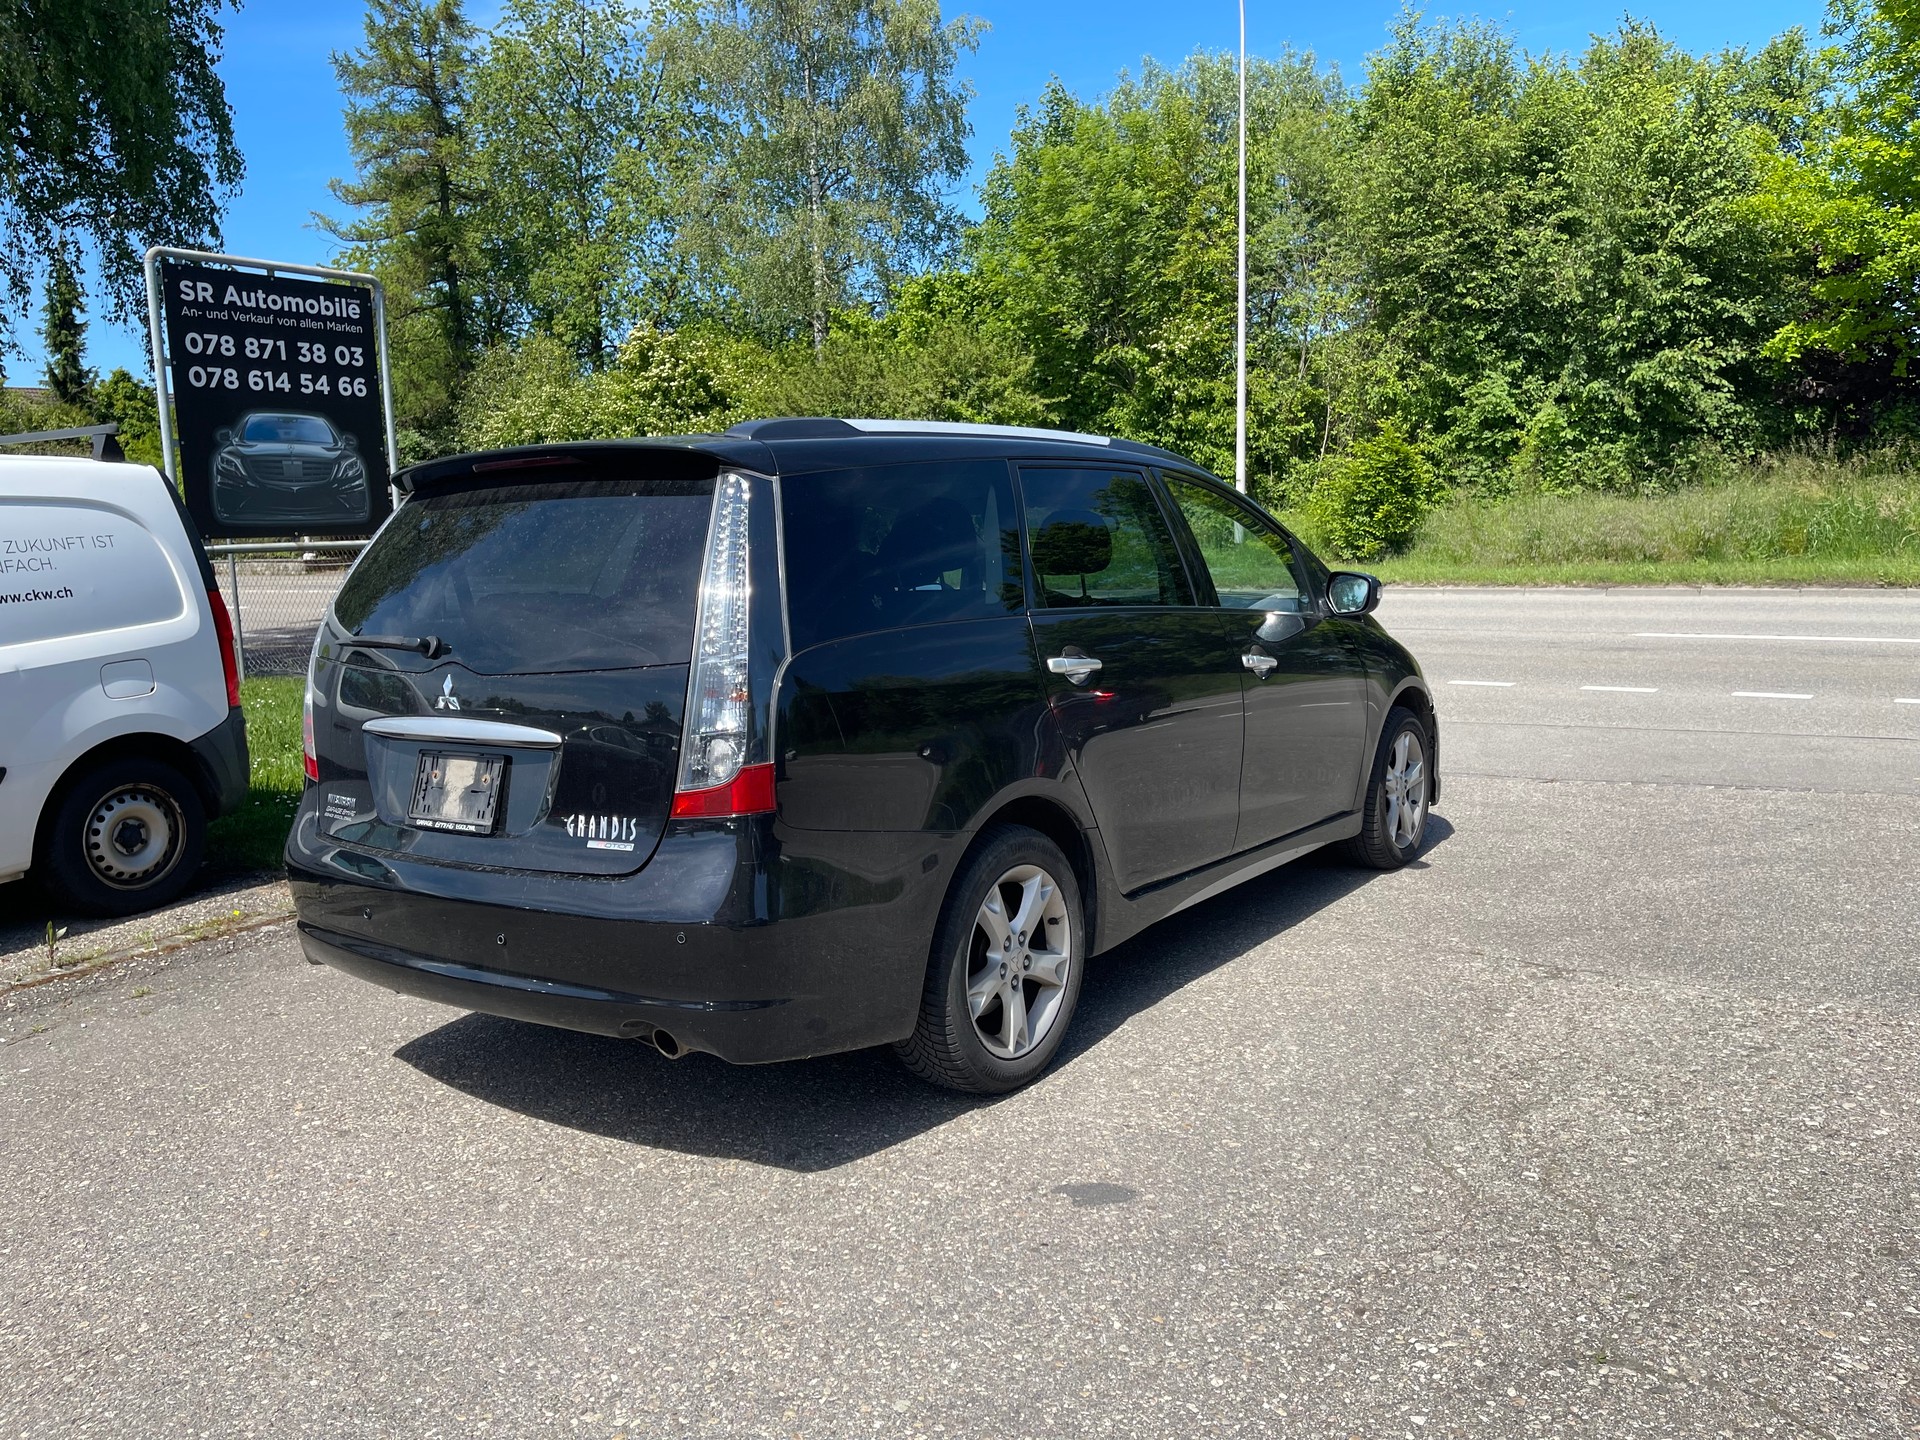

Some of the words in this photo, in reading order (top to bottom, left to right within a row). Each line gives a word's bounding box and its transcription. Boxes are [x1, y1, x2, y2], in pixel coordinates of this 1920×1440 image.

[179, 280, 215, 304] SR
[223, 285, 360, 319] Automobile
[181, 306, 203, 317] An-
[206, 310, 229, 320] und
[231, 311, 275, 325] Verkauf
[277, 317, 297, 327] von
[299, 318, 324, 330] allen
[326, 321, 363, 334] Marken
[184, 332, 236, 357] 078
[244, 337, 287, 361] 871
[297, 341, 327, 364] 38
[334, 345, 364, 367] 03
[188, 366, 239, 390] 078
[248, 370, 291, 393] 614
[300, 374, 330, 395] 54
[338, 377, 367, 398] 66
[3, 536, 85, 554] ZUKUNFT
[91, 534, 115, 549] IST
[566, 814, 637, 841] GRANDIS
